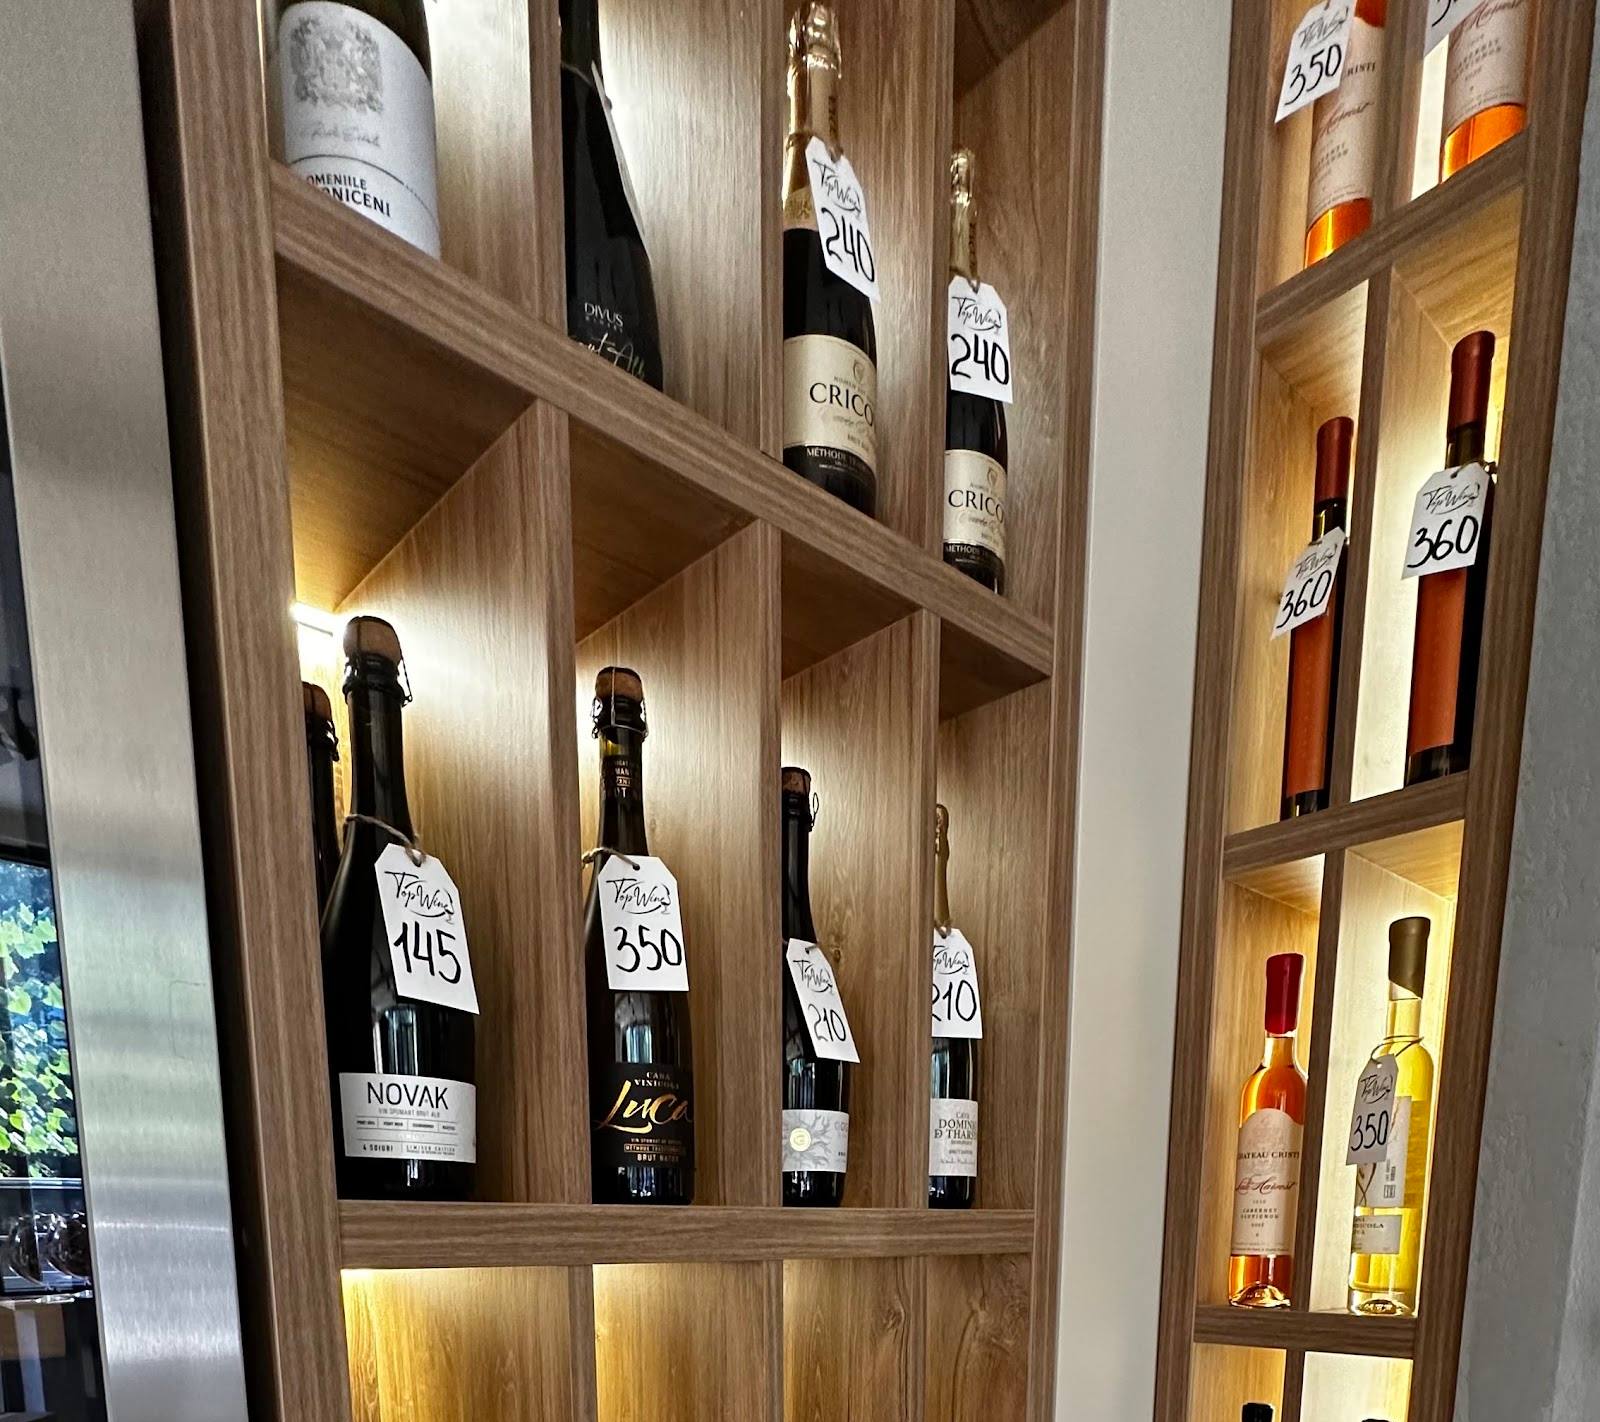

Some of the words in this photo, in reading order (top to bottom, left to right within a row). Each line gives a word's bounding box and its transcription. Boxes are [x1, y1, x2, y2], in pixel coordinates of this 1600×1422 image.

[1285, 44, 1342, 105] 350
[821, 207, 875, 282] 240
[584, 302, 624, 327] DIVUS
[950, 333, 1010, 385] 240
[1407, 515, 1479, 568] 360
[1276, 569, 1332, 628] 360
[393, 920, 462, 984] 145
[614, 924, 682, 972] 350
[807, 1003, 847, 1041] 210
[367, 1081, 449, 1110] NOVAK
[1351, 1110, 1389, 1151] 350
[637, 1153, 657, 1162] BRUT
